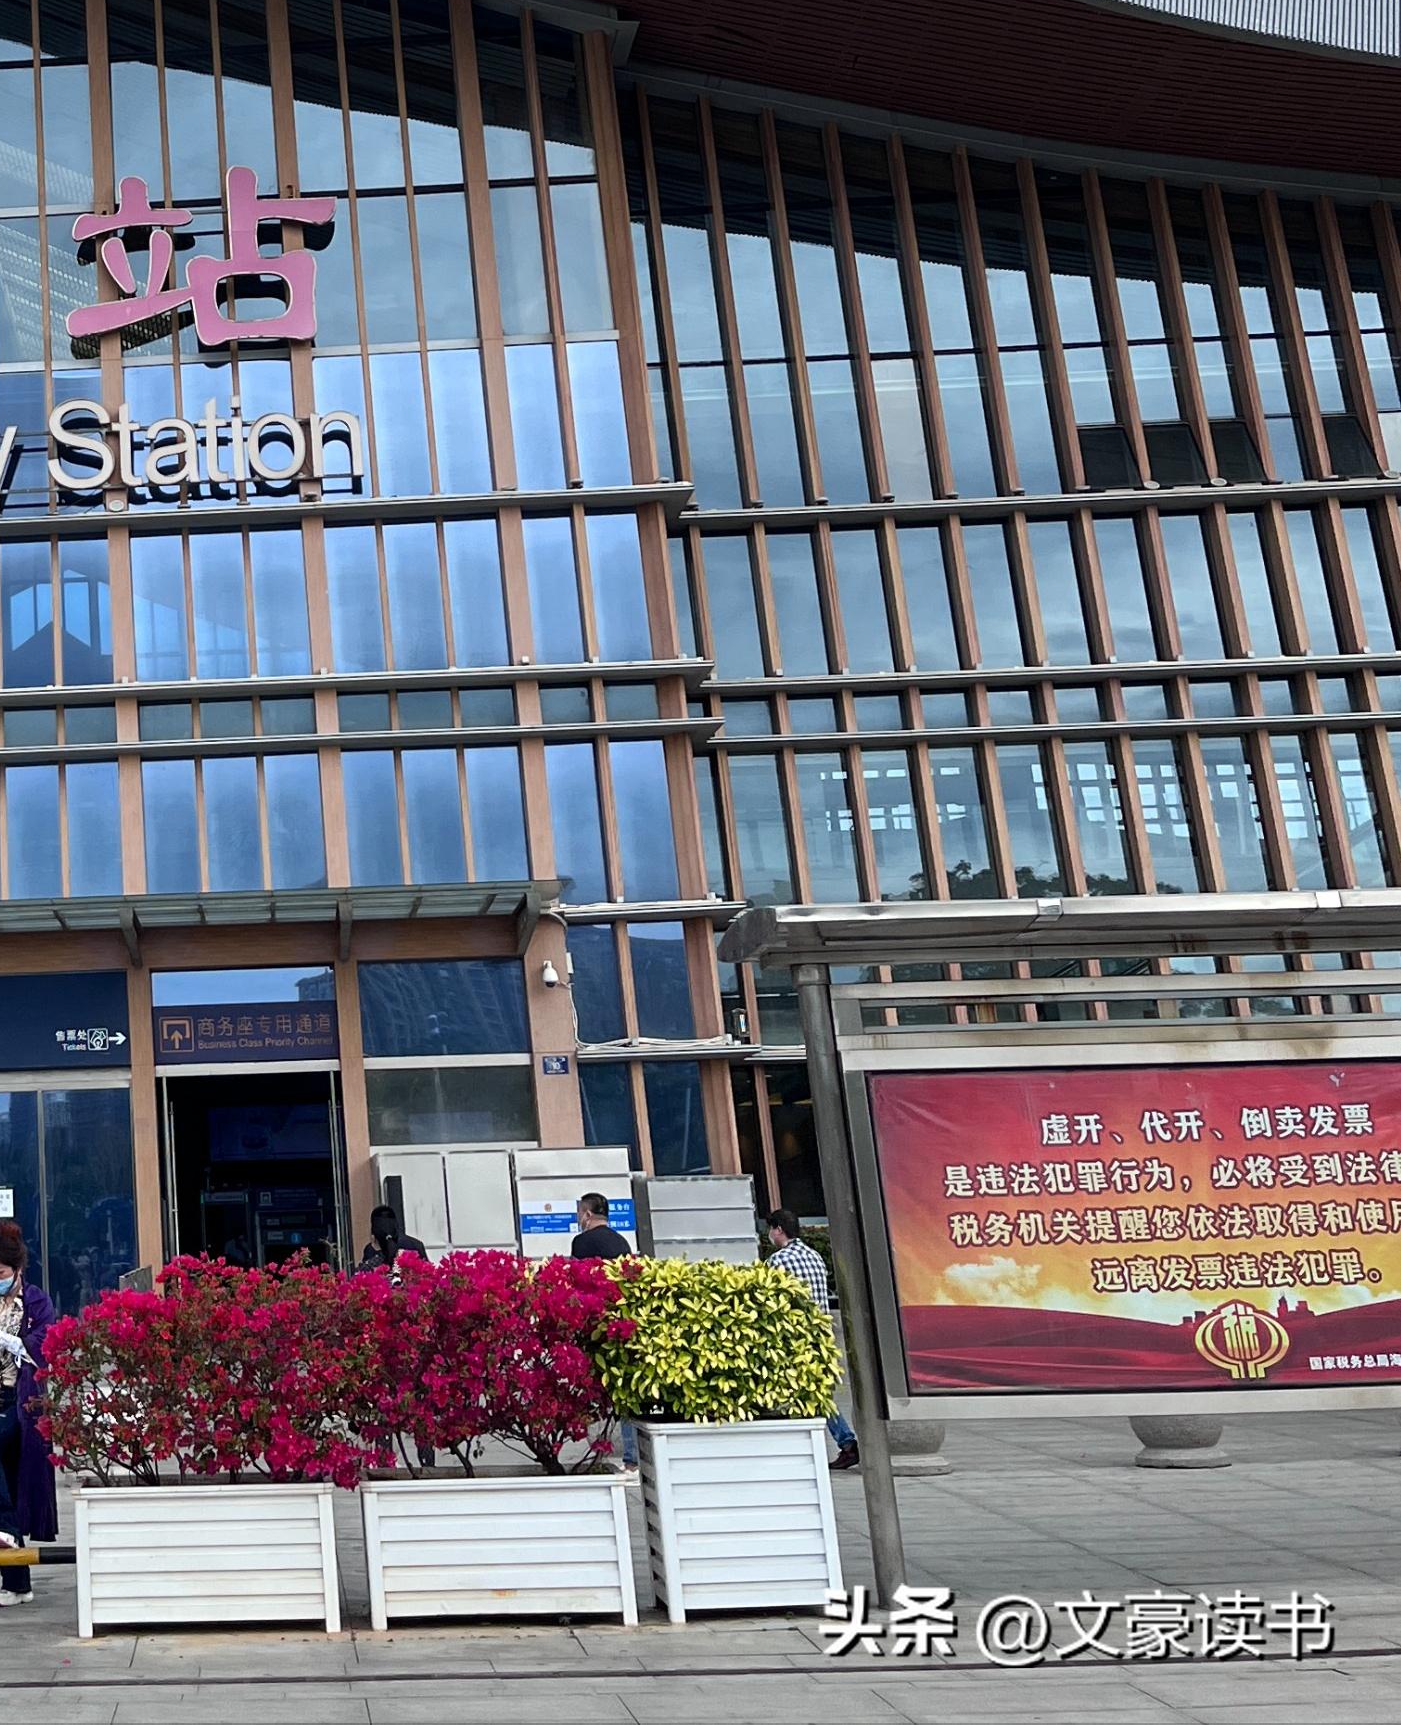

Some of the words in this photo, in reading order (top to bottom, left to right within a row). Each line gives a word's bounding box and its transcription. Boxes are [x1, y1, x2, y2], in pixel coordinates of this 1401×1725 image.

[47, 394, 365, 492] Station
[55, 1029, 88, 1042] 售票处
[196, 1013, 332, 1038] 商务座专用通道
[62, 1042, 87, 1052] Tickets
[198, 1039, 238, 1049] Business
[238, 1038, 263, 1048] Class
[264, 1037, 295, 1048] Priority
[297, 1035, 334, 1046] Channel
[1040, 1102, 1374, 1147] 虚开、代开、倒卖发票
[1091, 1249, 1383, 1293] 远离发票违法犯罪。
